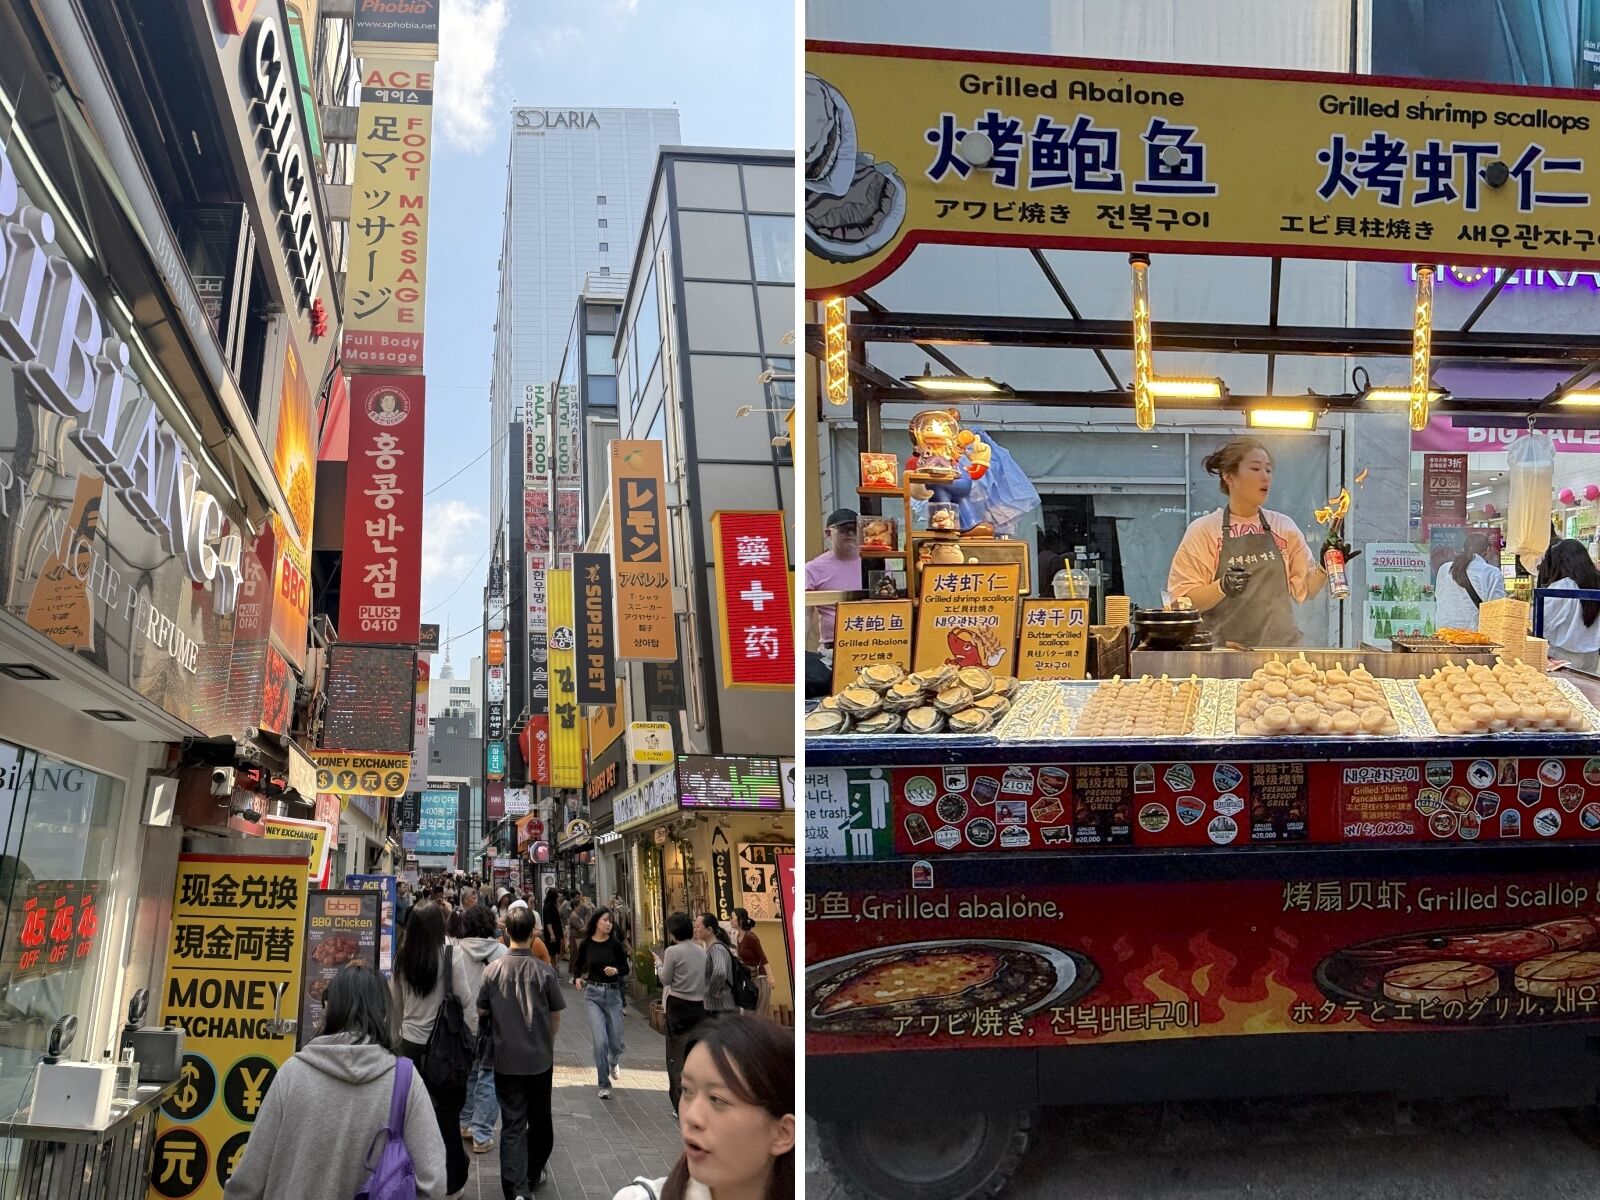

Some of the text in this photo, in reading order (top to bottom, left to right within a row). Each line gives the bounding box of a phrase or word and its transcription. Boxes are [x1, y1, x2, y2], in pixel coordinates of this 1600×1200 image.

[356, 20, 437, 30] www.xphobia.net
[365, 70, 431, 89] ACE
[375, 90, 419, 103] 에이스
[959, 74, 1185, 106] Grilled Abalone
[516, 110, 600, 128] SOLARIA
[1319, 95, 1590, 134] Grilled shrimp scallops
[352, 116, 402, 320] 足マッサージ
[934, 199, 1070, 224] アワビ焼き
[1096, 204, 1210, 231] 전복구이
[394, 118, 426, 323] FOOT MASSAGE
[1280, 215, 1434, 241] エビ貝柱焼き
[158, 230, 200, 328] BiBiANG
[345, 335, 420, 348] Full Body
[346, 349, 417, 363] Massage
[535, 386, 545, 474] HALAL FOOD
[1468, 427, 1519, 443] BIG
[1431, 478, 1447, 487] 70
[363, 432, 405, 598] 홍콩반점
[627, 482, 659, 562] レモン
[282, 557, 306, 617] BBQ
[619, 572, 668, 588] アパレル
[934, 573, 1009, 592] 烤虾仁
[40, 504, 199, 674] NICHE PERFUME
[953, 595, 980, 603] shrimp
[982, 595, 1014, 603] scallops
[360, 606, 400, 618] PLUS+
[944, 605, 994, 613] エビ貝柱焼き
[1027, 608, 1084, 626] 烤干贝
[361, 620, 398, 632] 0410
[844, 614, 906, 631] 烤鲍鱼
[935, 615, 999, 627] 새우관자구이
[585, 585, 606, 692] SUPER PET
[633, 638, 660, 648] 상아탑
[744, 626, 780, 661] 药
[838, 638, 908, 647] Grilled Abalone
[1039, 639, 1070, 648] scallops
[852, 653, 893, 661] アワビ焼き
[1034, 661, 1070, 671] 관자구이
[554, 666, 576, 729] 김밥
[352, 758, 408, 769] EXCHANGE
[537, 743, 547, 782] SUNSKIN
[1344, 767, 1419, 783] 새우관자구이
[1003, 781, 1033, 791] ZION
[1261, 785, 1297, 793] PREMIUM
[1353, 785, 1408, 795] Grilled Shrimp
[1261, 792, 1296, 800] SEAFOOD
[1267, 799, 1289, 807] GRILL
[1351, 794, 1383, 803] Pancake
[281, 829, 319, 840] EXCHANGE
[180, 873, 298, 910] 现金兑换
[362, 881, 379, 890] ACE
[1417, 887, 1498, 911] Grilled
[1505, 882, 1588, 909] Scallop
[862, 895, 1064, 921] Grilled abalone,
[312, 917, 372, 928] BBQ Chicken
[174, 924, 294, 962] 現金両替
[20, 950, 40, 969] OFF
[49, 945, 68, 963] OFF
[168, 978, 289, 1010] MONEY
[1050, 1000, 1199, 1034] 전복버터구이
